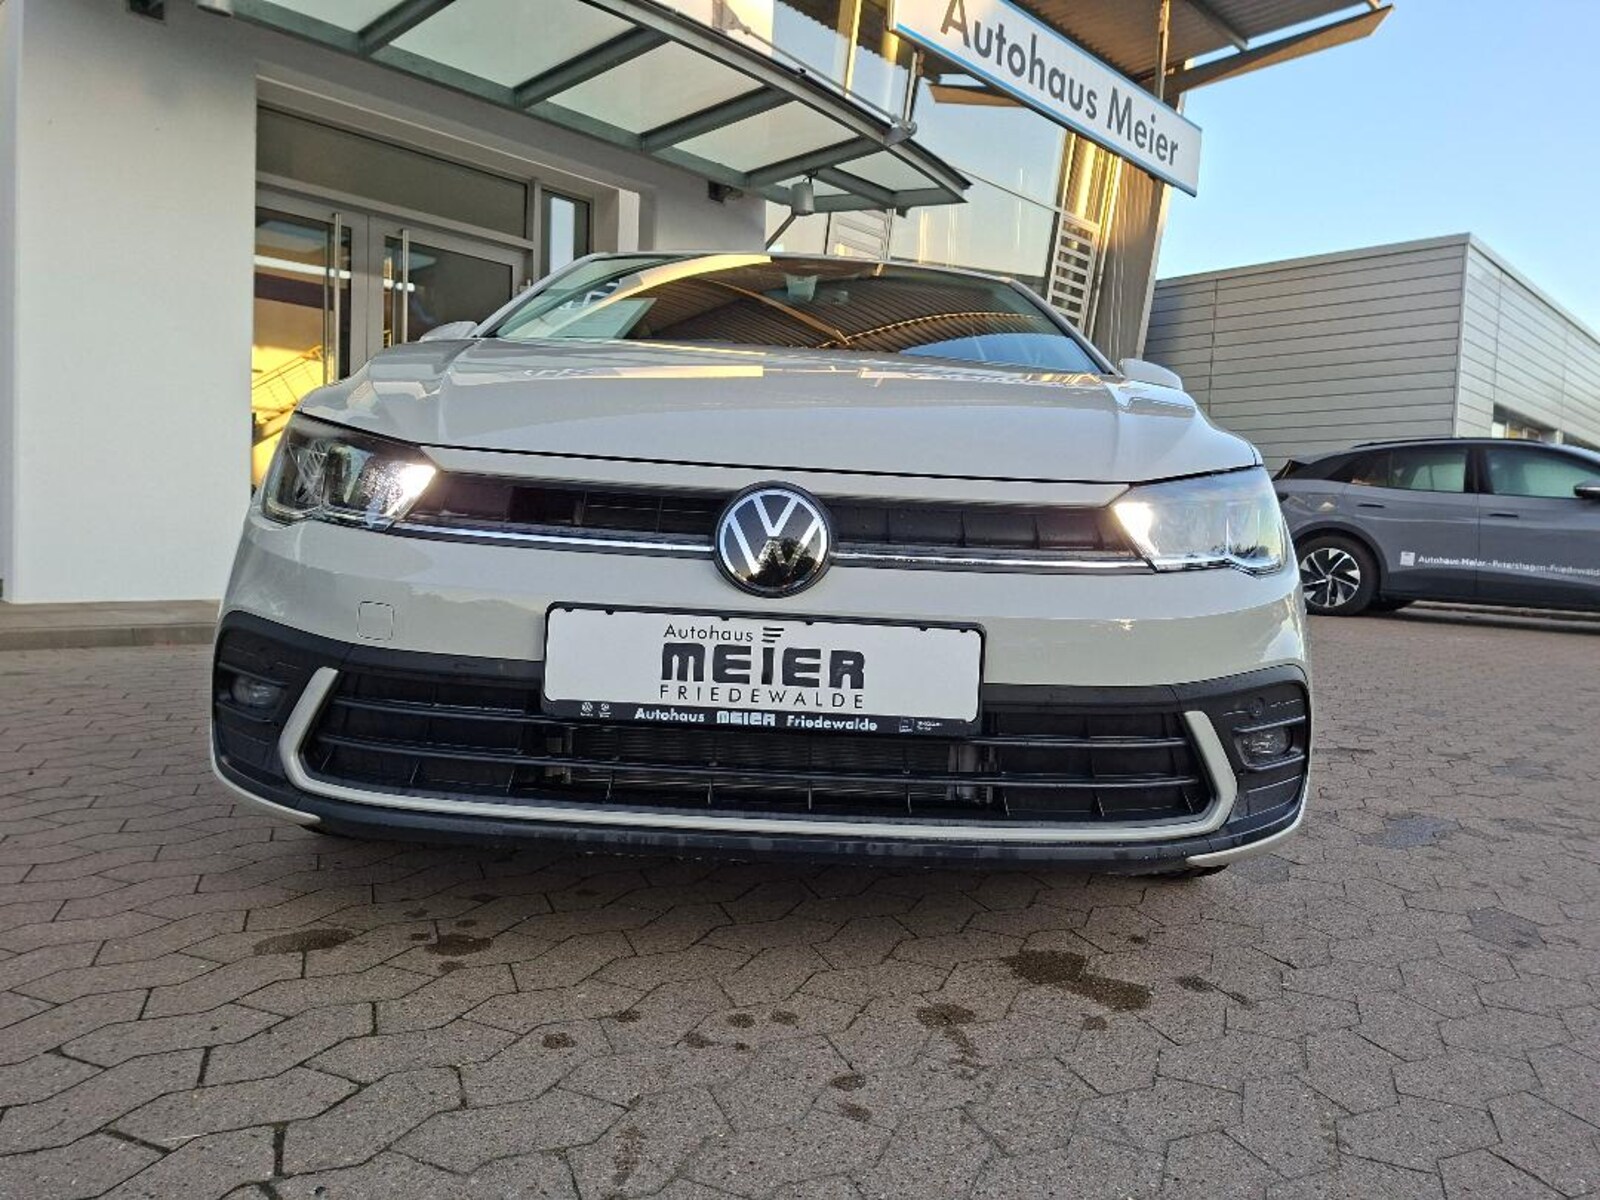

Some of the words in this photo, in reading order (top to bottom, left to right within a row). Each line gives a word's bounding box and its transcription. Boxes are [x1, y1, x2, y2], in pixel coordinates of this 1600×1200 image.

[940, 0, 1098, 119] Autohaus
[1107, 86, 1178, 166] Meier
[1418, 555, 1459, 566] Autohaus
[663, 624, 754, 642] Autohaus
[659, 684, 863, 709] FRIEDEWALDE
[634, 707, 705, 723] Autohaus
[716, 710, 776, 727] MEIER
[786, 715, 878, 731] Friedewalde
